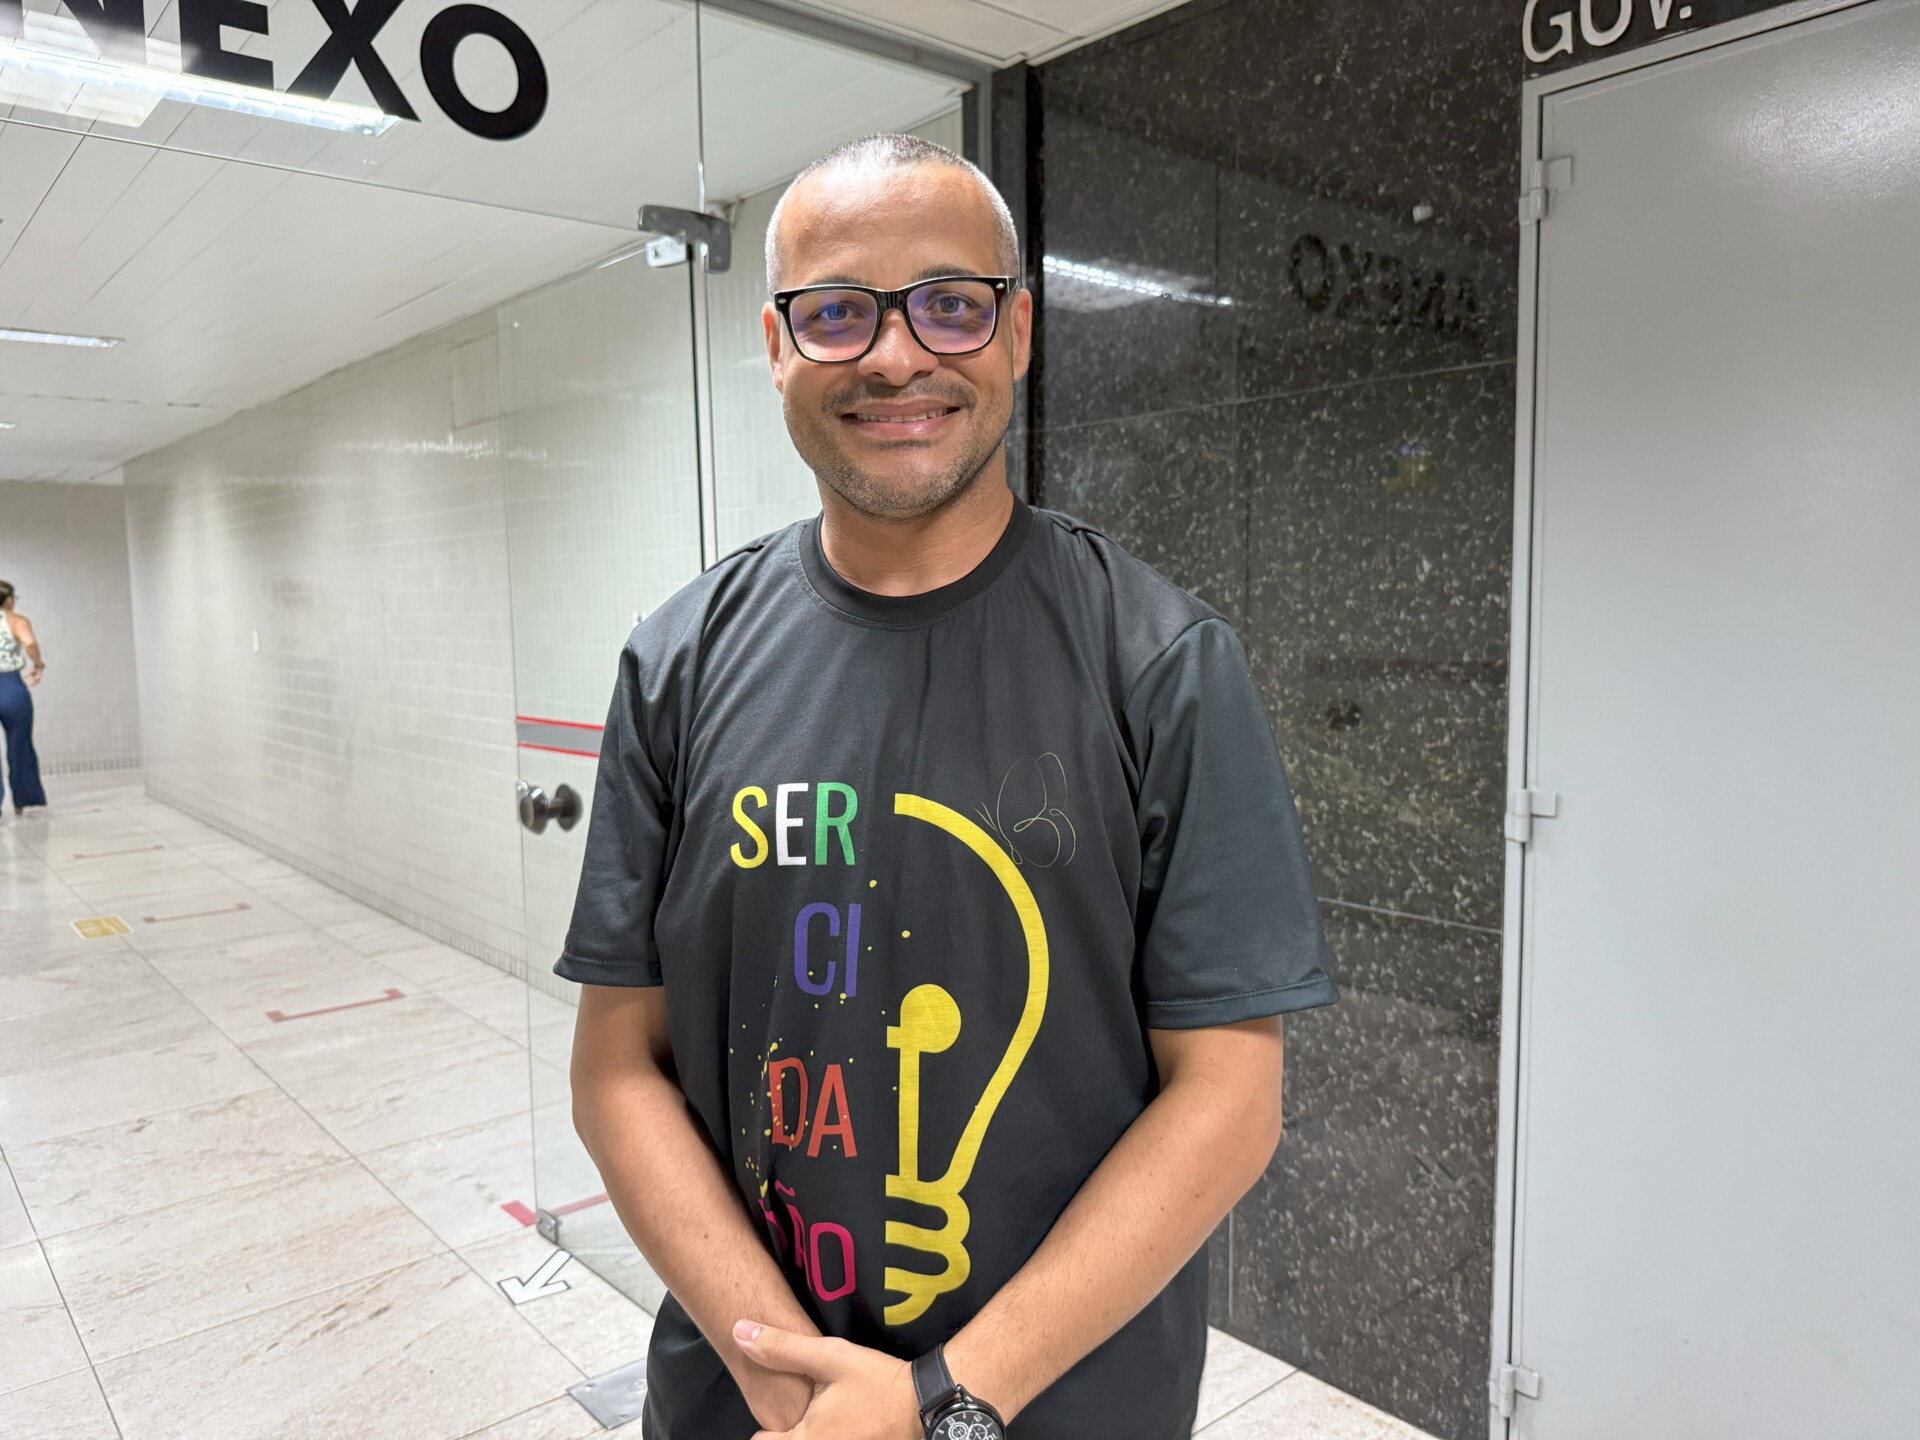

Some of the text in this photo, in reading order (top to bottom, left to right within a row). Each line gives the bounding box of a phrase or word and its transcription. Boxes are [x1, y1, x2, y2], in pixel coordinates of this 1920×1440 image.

[730, 782, 858, 869] SER
[794, 902, 861, 997] CI
[768, 1057, 858, 1158] DA
